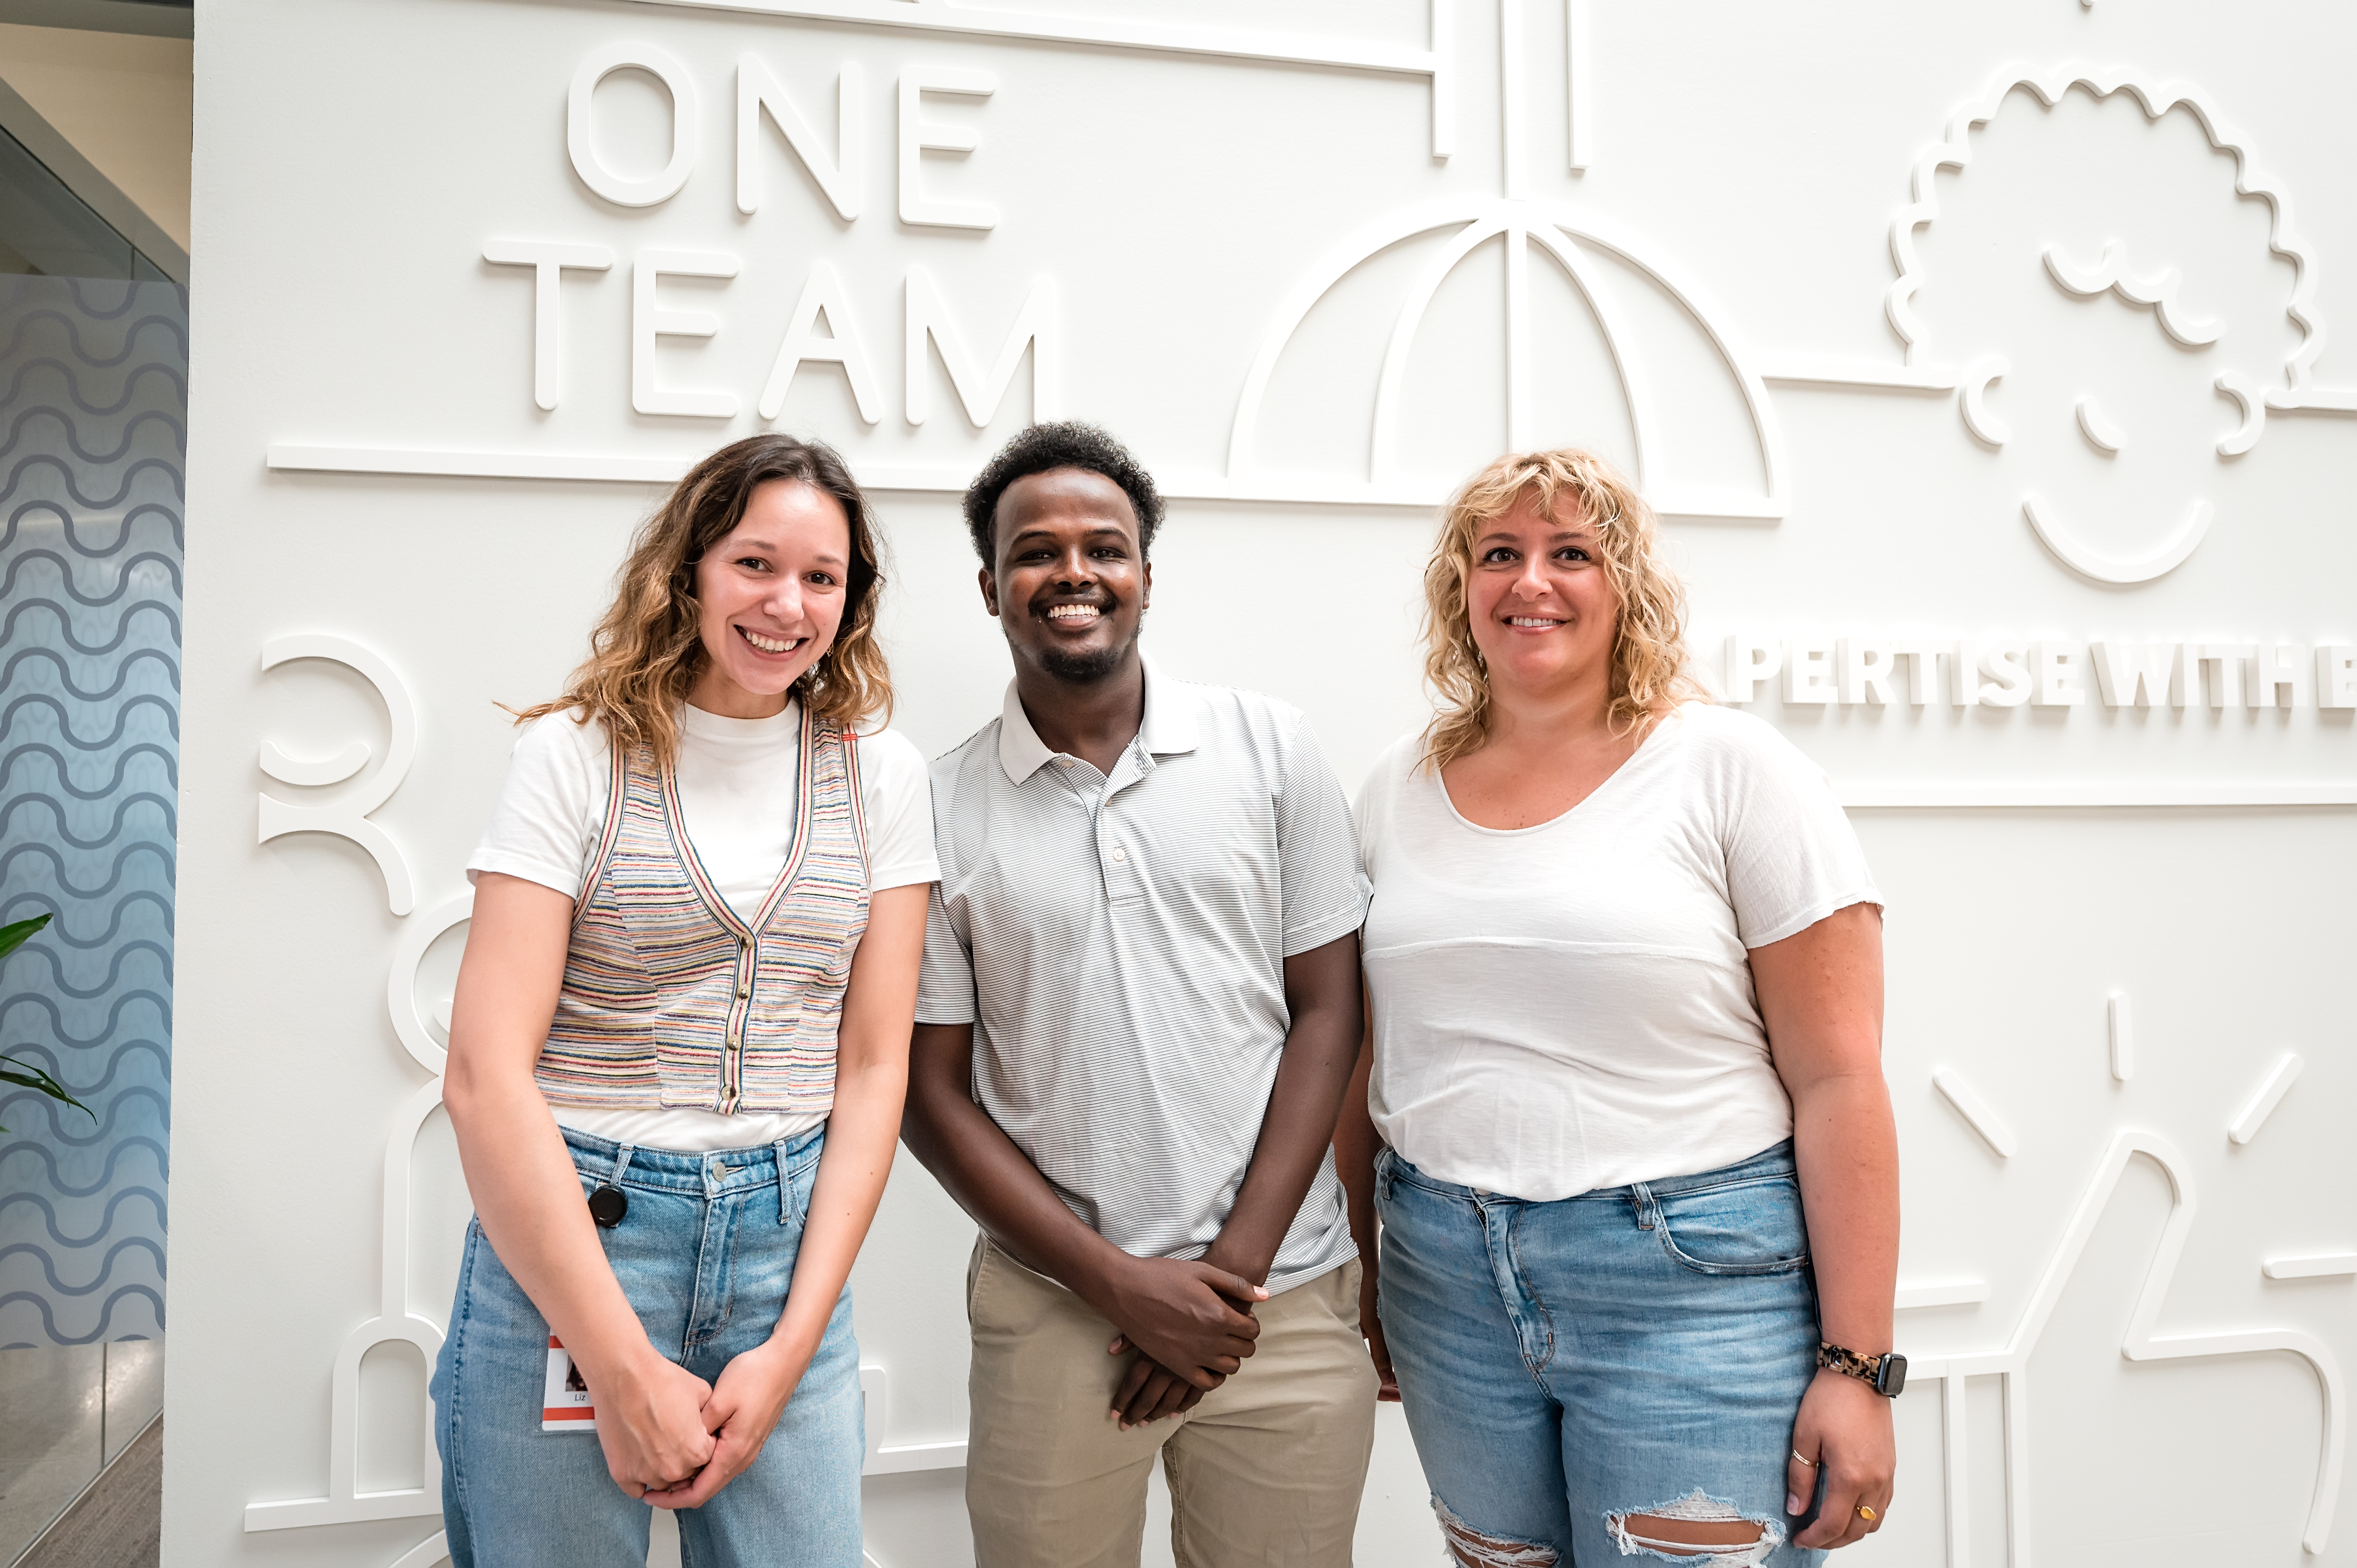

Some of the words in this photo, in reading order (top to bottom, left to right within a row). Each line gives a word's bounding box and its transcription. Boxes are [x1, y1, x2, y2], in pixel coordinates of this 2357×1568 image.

[567, 41, 999, 229] ONE
[483, 240, 1056, 427] TEAM
[2090, 642, 2306, 708] WITH
[575, 1393, 586, 1401] Liz
